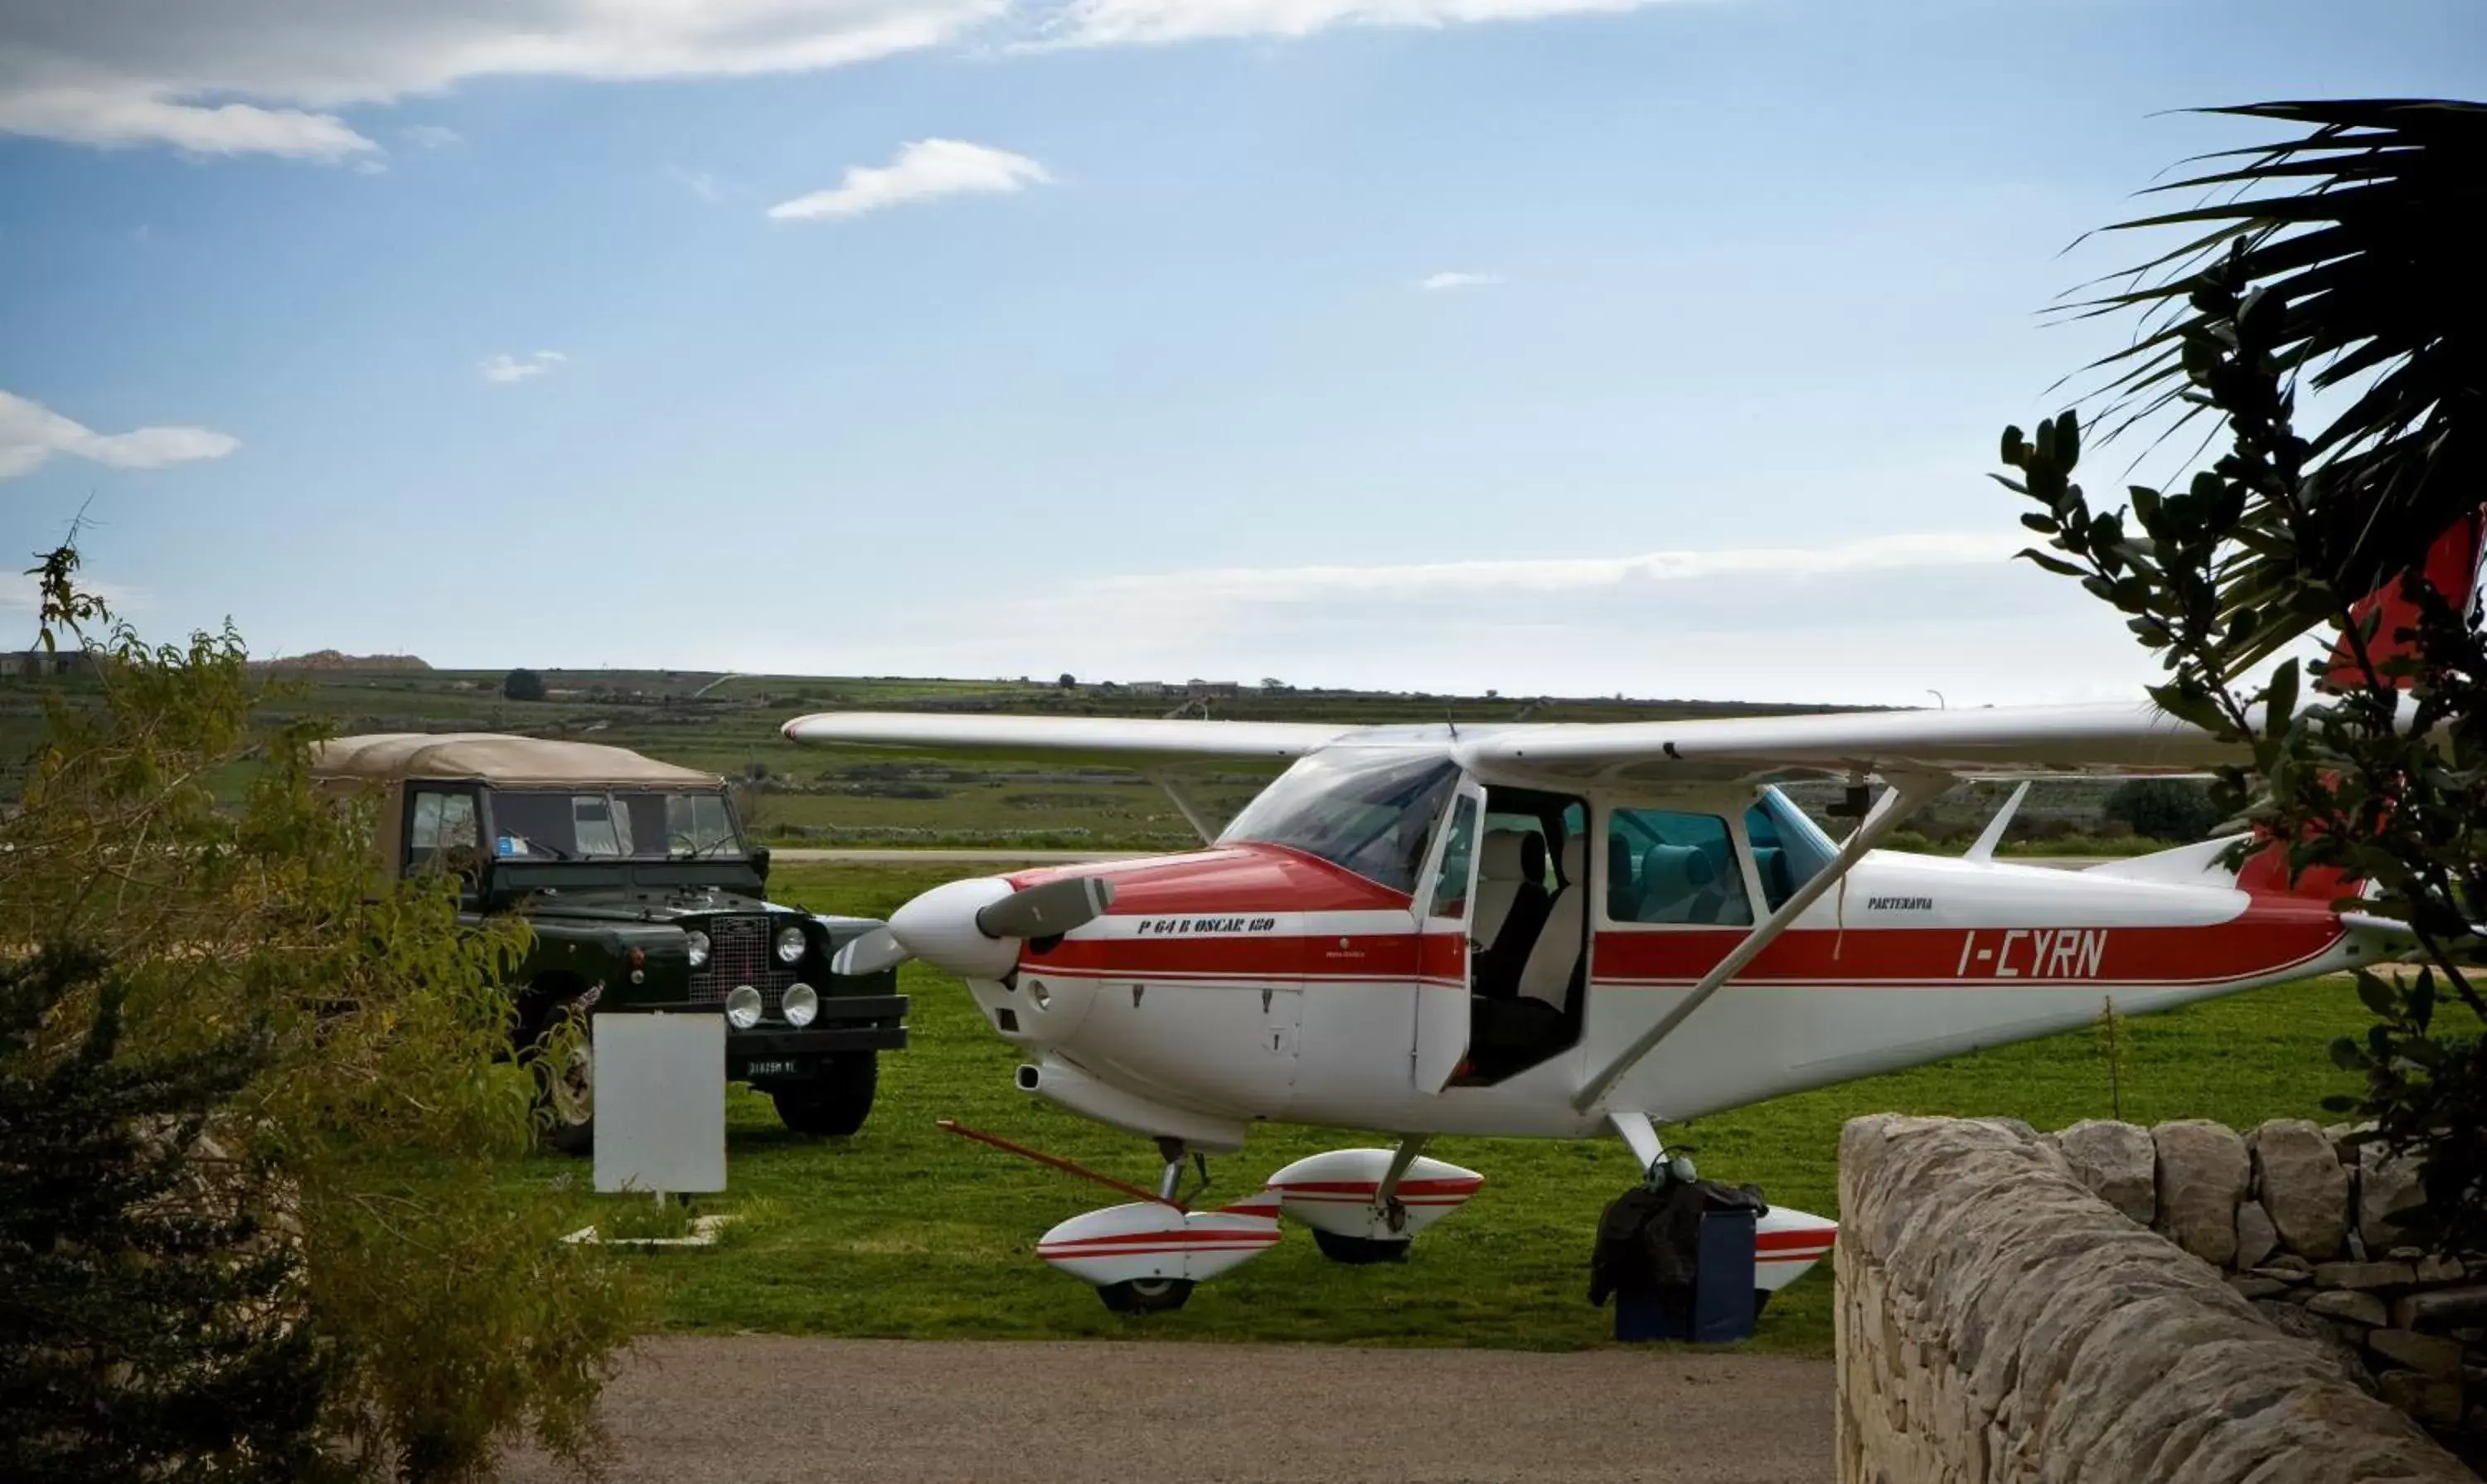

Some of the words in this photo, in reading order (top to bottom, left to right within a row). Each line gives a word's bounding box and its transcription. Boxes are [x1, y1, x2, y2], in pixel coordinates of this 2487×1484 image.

[1137, 919, 1151, 934] P
[1154, 919, 1176, 934] 64
[1179, 919, 1191, 934] B
[1194, 918, 1245, 933] OSCAR
[1956, 929, 2108, 977] I-CYRN
